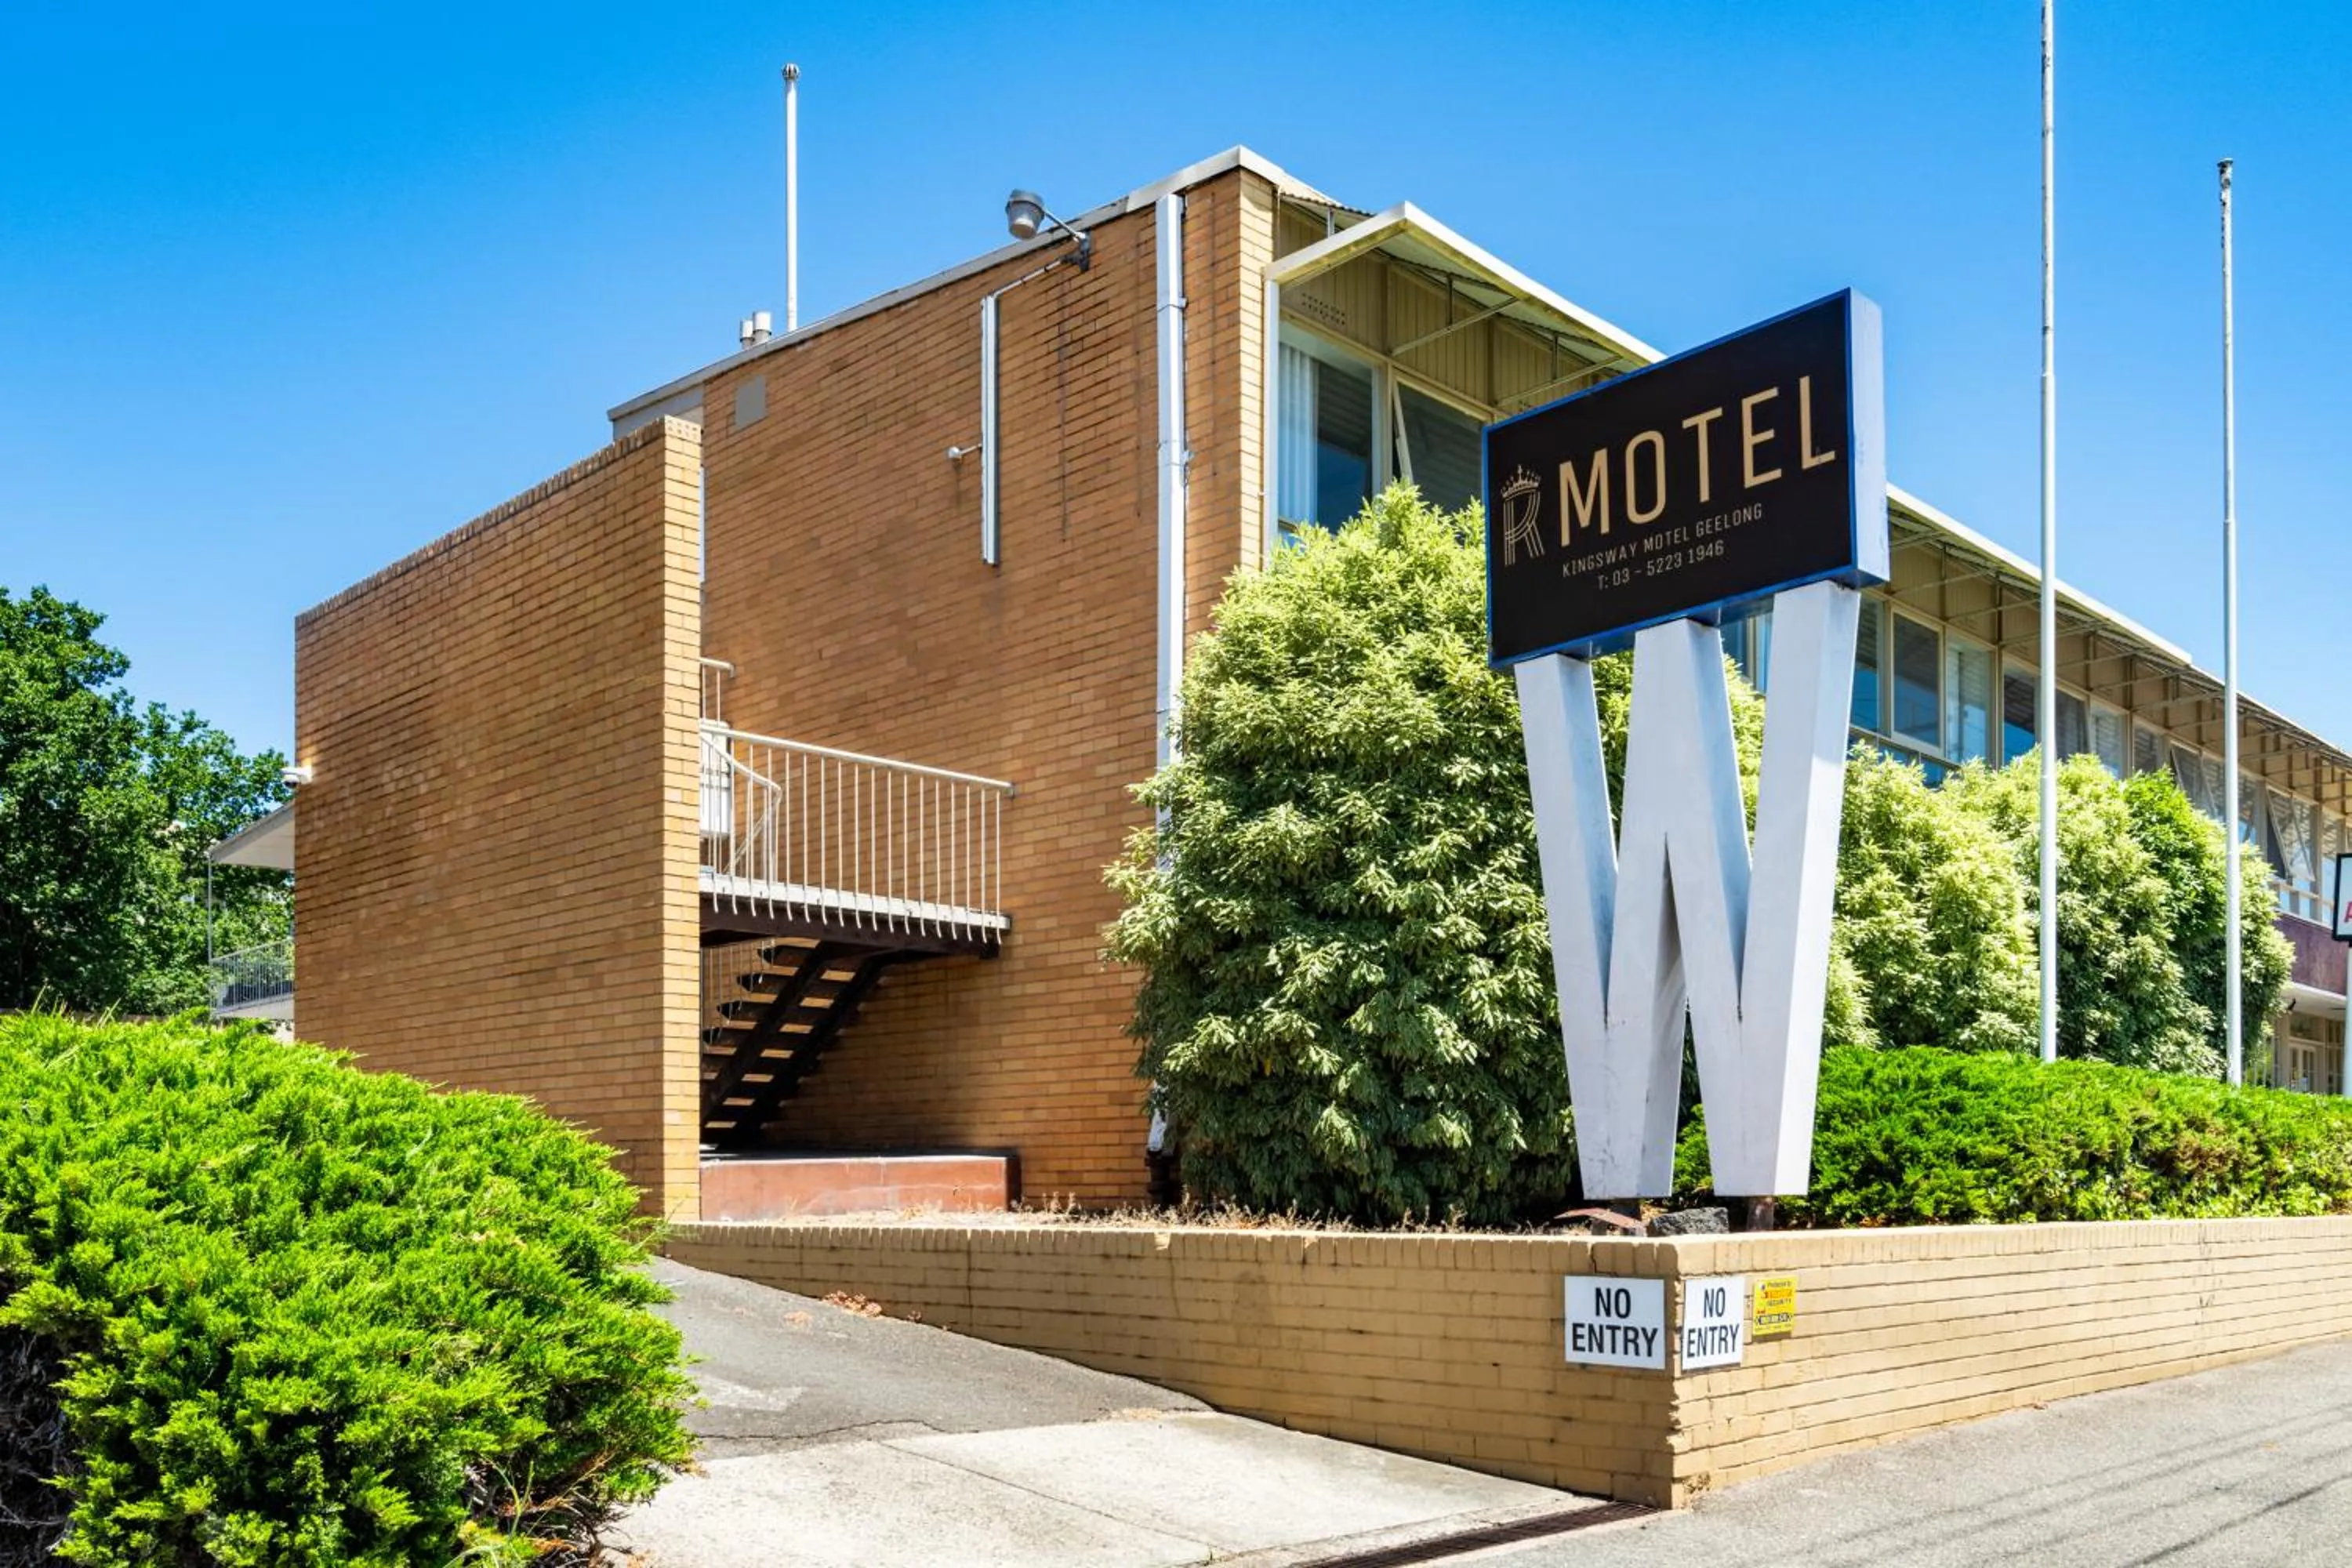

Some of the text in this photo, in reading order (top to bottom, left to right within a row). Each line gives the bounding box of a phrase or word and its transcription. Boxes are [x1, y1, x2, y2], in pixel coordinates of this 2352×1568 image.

[1559, 375, 1836, 547] MOTEL
[1563, 503, 1762, 578] KINGSWAY MOTEL GEELONG
[1597, 575, 1609, 590] T:
[1613, 568, 1630, 586] 03
[1646, 552, 1682, 576] 5223
[1687, 539, 1725, 564] 1946
[1595, 1287, 1632, 1319] NO
[1704, 1287, 1726, 1318] NO
[1572, 1323, 1658, 1357] ENTRY
[1686, 1323, 1740, 1358] ENTRY
